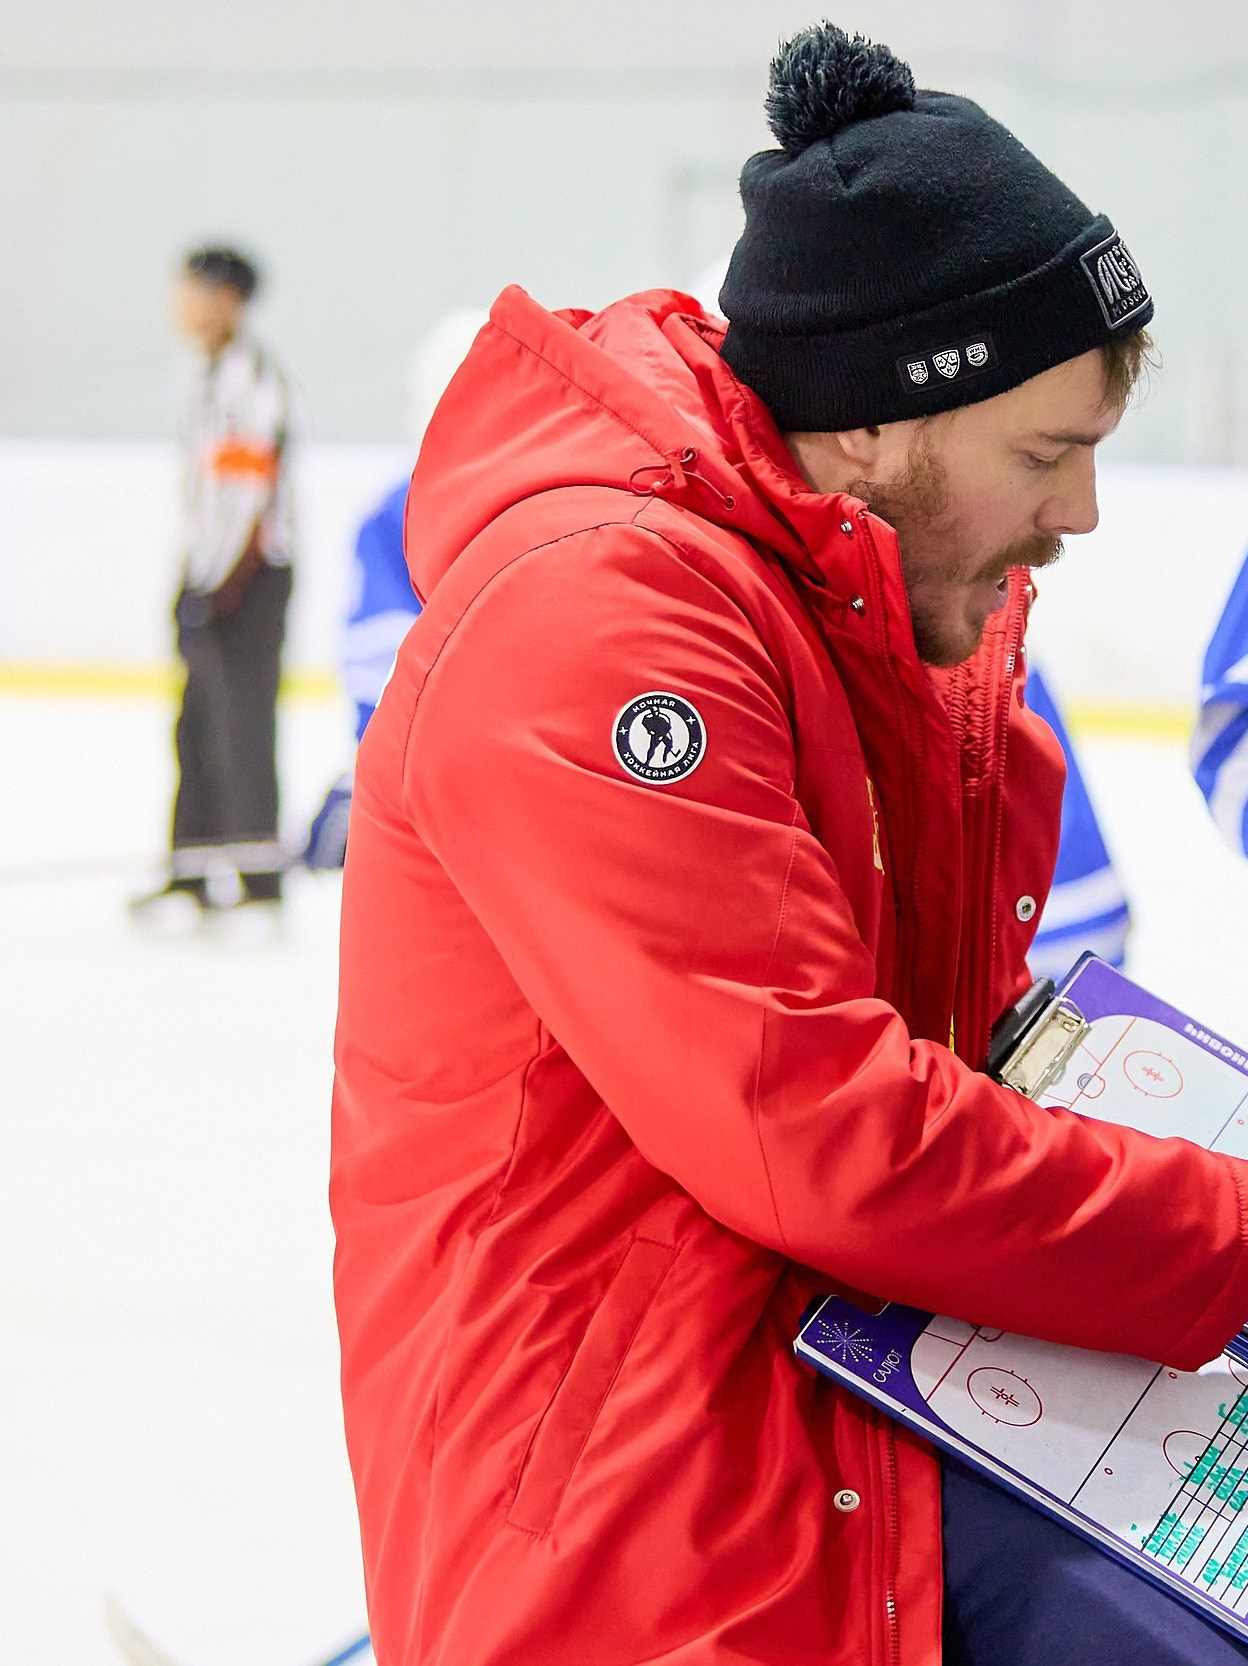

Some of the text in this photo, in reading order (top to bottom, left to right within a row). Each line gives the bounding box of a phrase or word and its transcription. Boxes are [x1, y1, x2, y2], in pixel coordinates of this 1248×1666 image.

[632, 699, 676, 713] НОЧНАЯ
[623, 741, 700, 778] ХОККЕЙНАЯ ЛИГА
[873, 1349, 904, 1383] САЛЮТ
